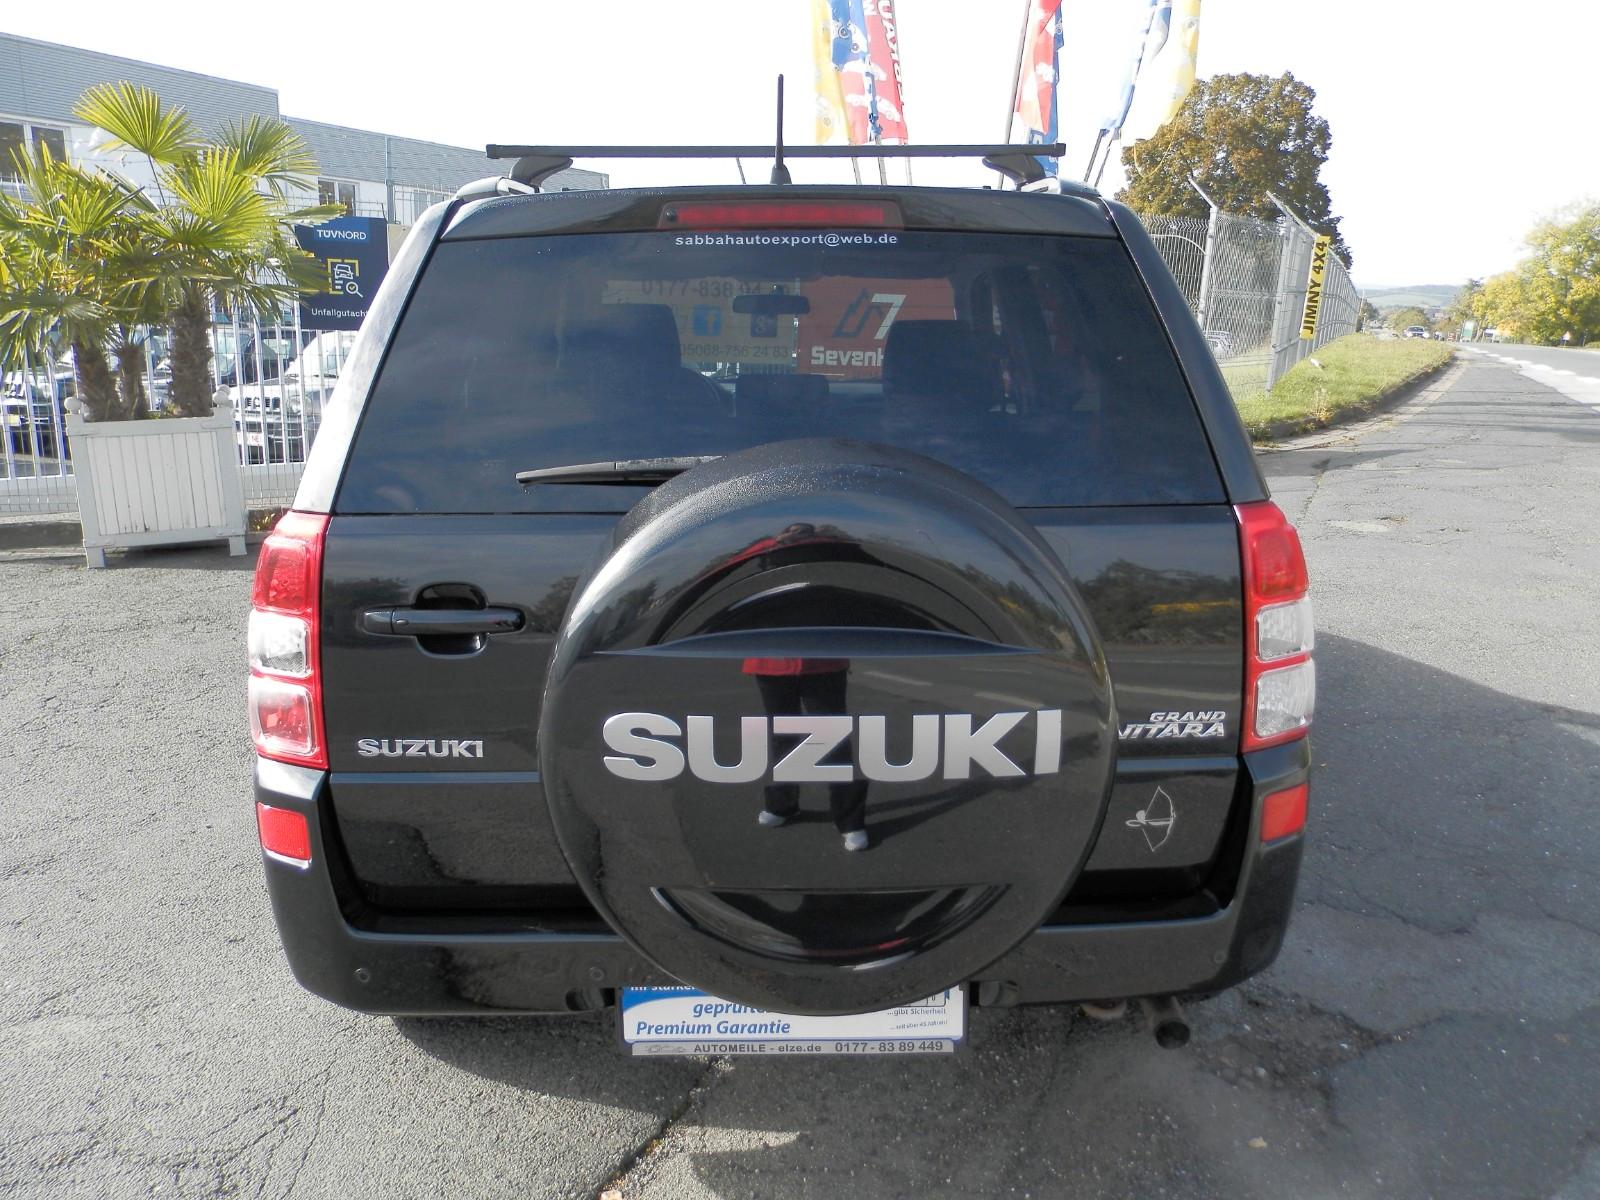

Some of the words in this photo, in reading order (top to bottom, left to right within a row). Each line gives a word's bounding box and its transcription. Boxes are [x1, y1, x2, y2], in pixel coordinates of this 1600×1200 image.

[675, 233, 898, 247] sabbahautoexport@web.de
[1302, 279, 1321, 334] JIMNY
[1149, 710, 1226, 722] GRAND
[357, 738, 484, 758] SUZUKI
[602, 709, 1063, 783] SUZUKI
[636, 1020, 712, 1035] Premium
[716, 1020, 791, 1035] Garantie
[694, 1043, 766, 1053] AUTOMEILE
[778, 1043, 822, 1053] elze.de
[834, 1042, 869, 1053] 0177
[878, 1041, 896, 1052] 83
[899, 1041, 916, 1052] 89
[918, 1040, 944, 1051] 449
